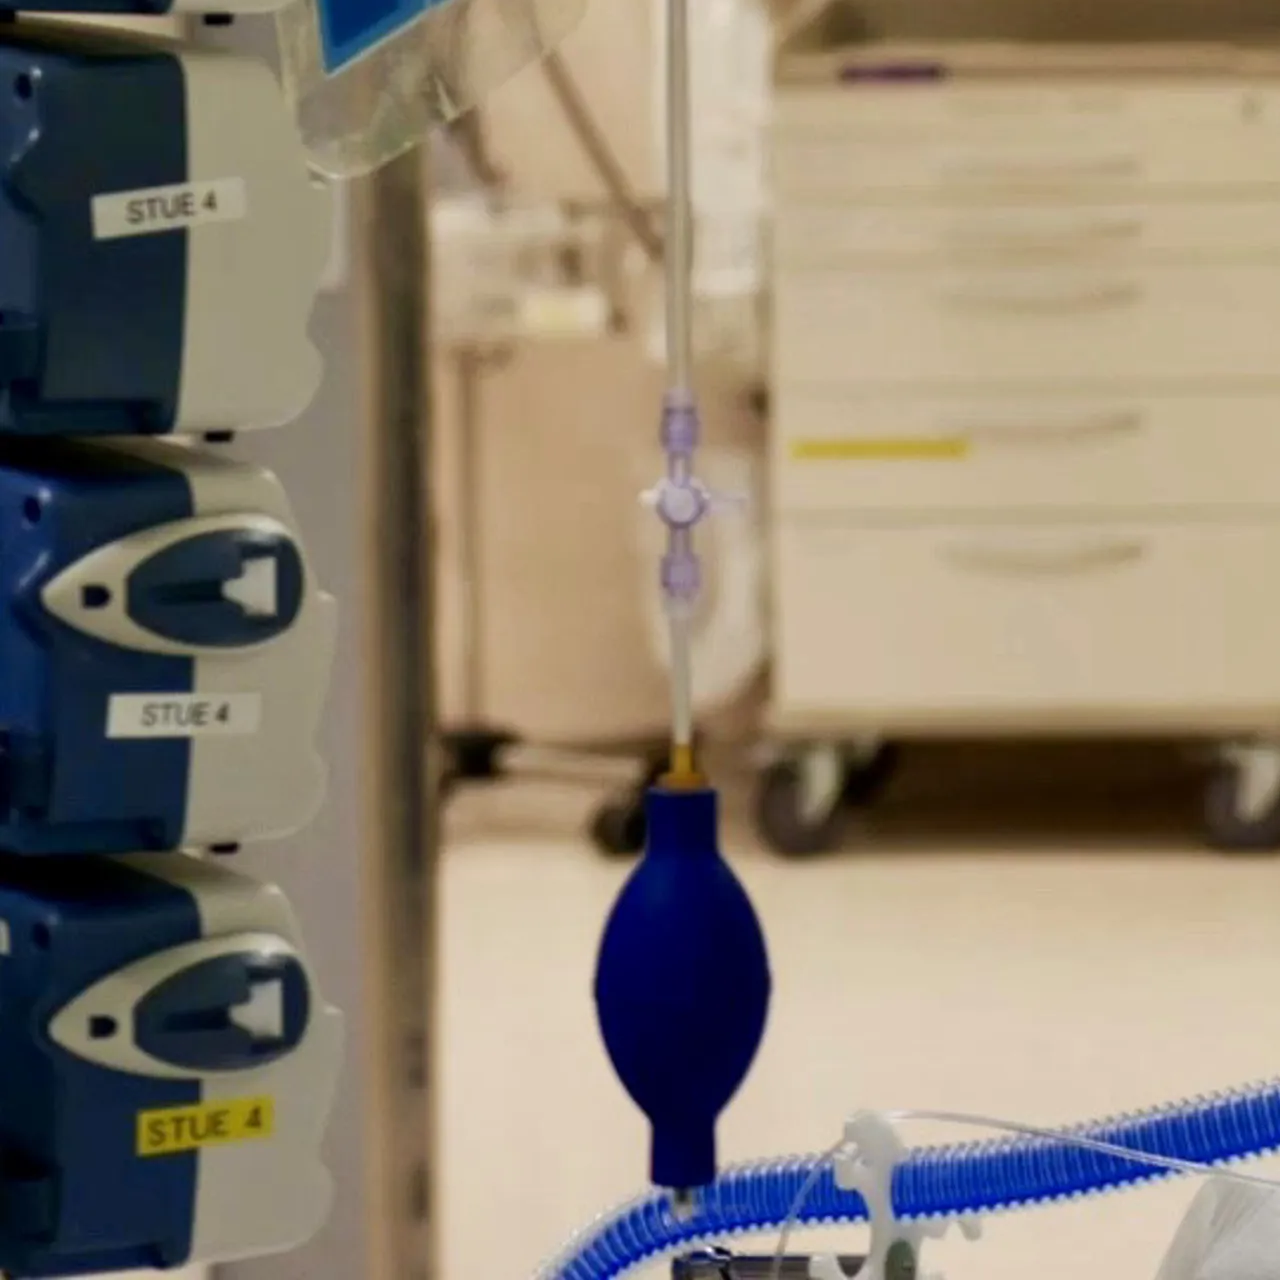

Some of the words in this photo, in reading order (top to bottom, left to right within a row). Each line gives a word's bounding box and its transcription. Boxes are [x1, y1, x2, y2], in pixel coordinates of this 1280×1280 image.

[125, 191, 197, 225] STUE
[201, 187, 219, 212] 4
[140, 700, 211, 728] STUE
[214, 700, 232, 725] 4
[147, 1107, 232, 1148] STUE
[244, 1104, 263, 1130] 4
